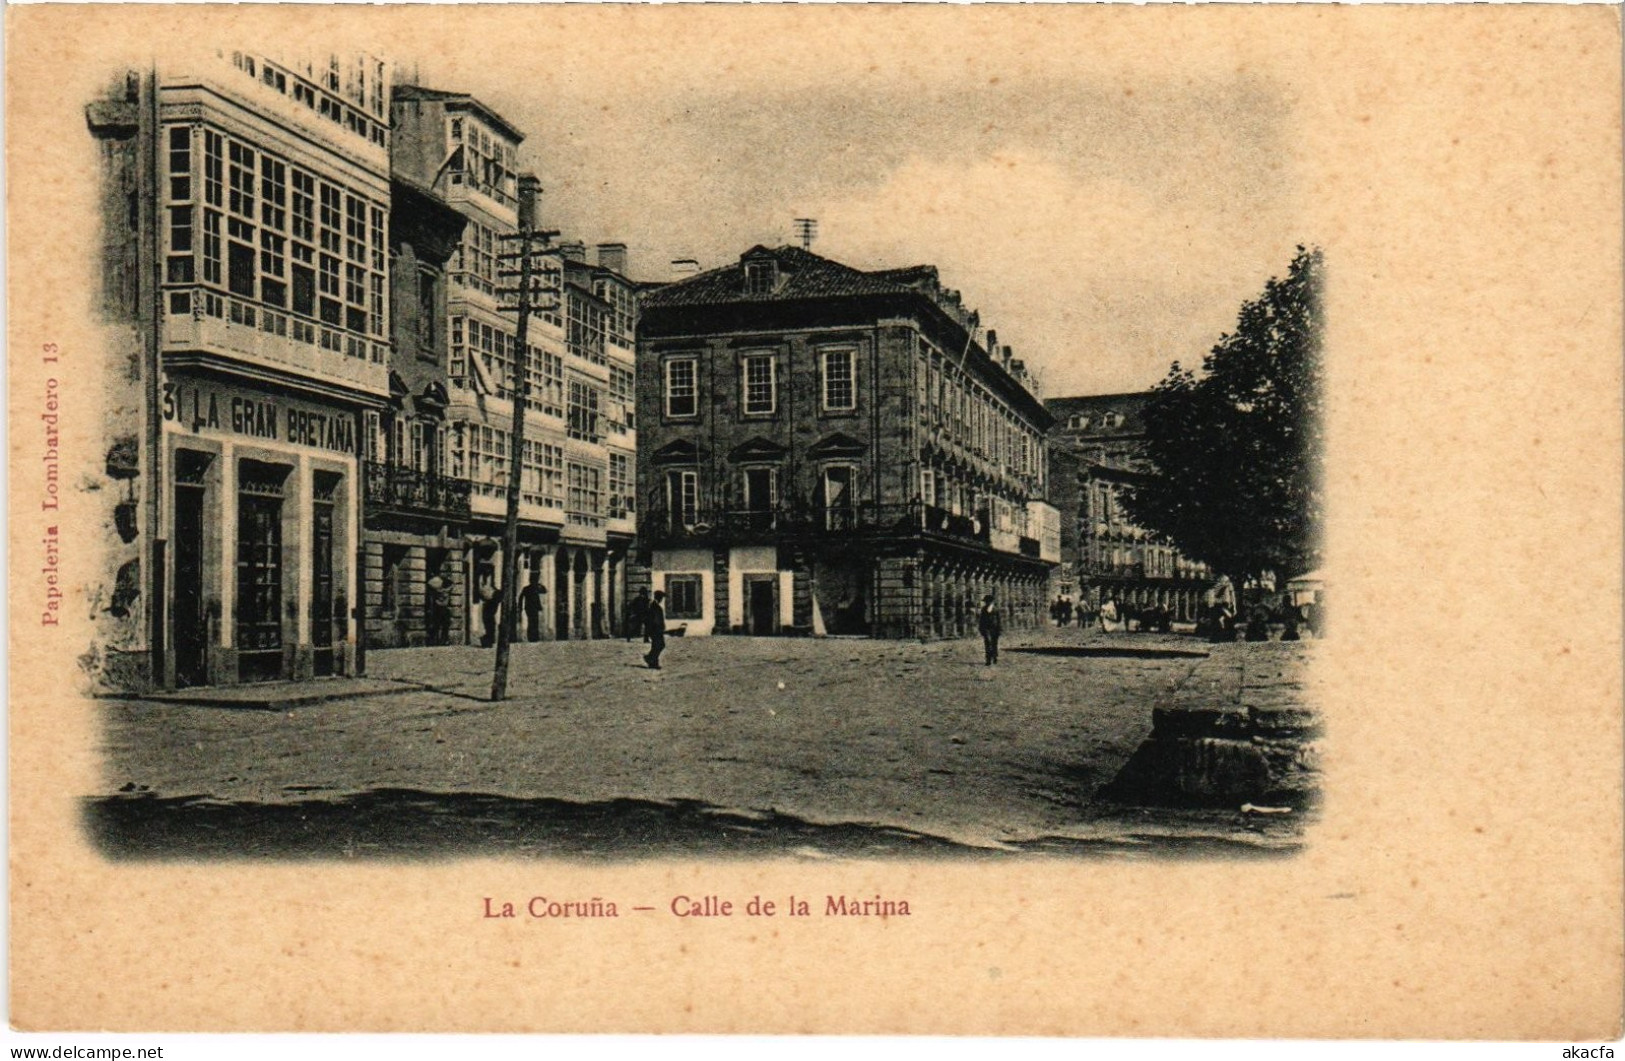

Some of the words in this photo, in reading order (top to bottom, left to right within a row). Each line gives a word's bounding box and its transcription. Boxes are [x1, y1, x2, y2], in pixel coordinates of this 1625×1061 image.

[163, 382, 182, 423] 31
[192, 388, 220, 432] LA
[231, 396, 278, 440] GRAN
[287, 407, 355, 453] BRETAÑA
